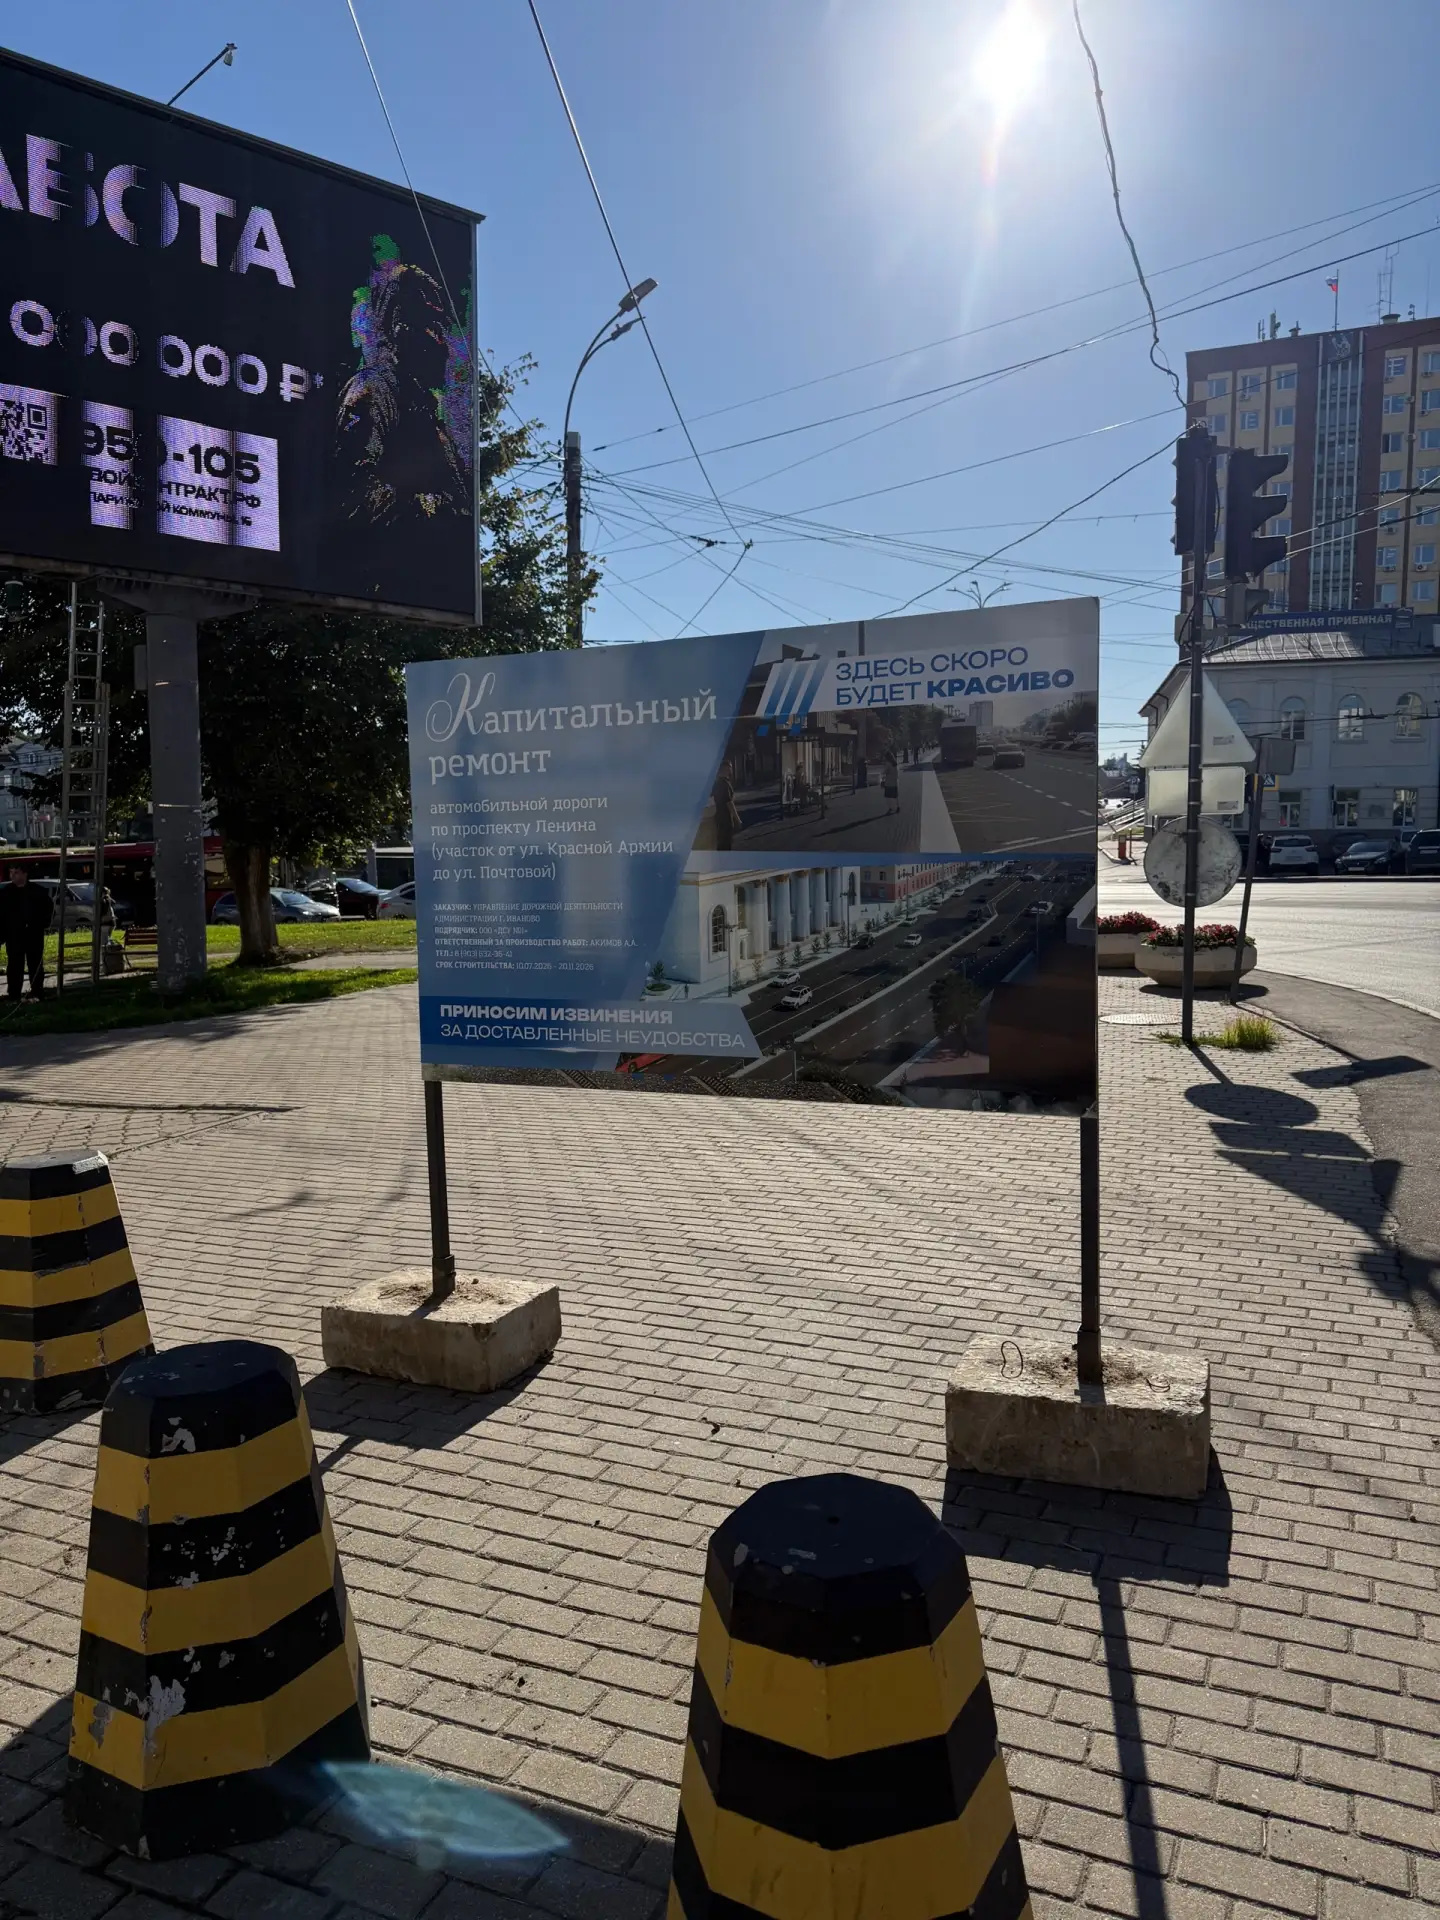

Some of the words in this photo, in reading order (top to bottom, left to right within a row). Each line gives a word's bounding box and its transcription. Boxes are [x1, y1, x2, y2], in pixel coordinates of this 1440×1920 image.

[1328, 615, 1392, 625] ПРИЕМНАЯ
[836, 657, 925, 683] ЗДЕСЬ
[930, 647, 1029, 672] СКОРО
[836, 681, 922, 707] БУДЕТ
[927, 669, 1075, 698] КРАСИВО
[425, 672, 717, 742] Капитальный
[428, 749, 551, 785] ремонт
[430, 797, 548, 814] автомобильной
[552, 797, 608, 813] дороги
[431, 825, 449, 836] по
[452, 821, 531, 838] проспекту
[535, 820, 597, 833] Ленина
[432, 843, 495, 860] (участок
[499, 845, 516, 857] от
[519, 845, 543, 859] ул.
[549, 841, 613, 858] Красной
[617, 840, 673, 857] Армии
[433, 868, 450, 881] до
[454, 867, 476, 880] ул.
[480, 862, 556, 880] Почтовой)
[433, 903, 472, 911] ЗАКАЗЧИК:
[473, 903, 520, 911] УПРАВЛЕНИЕ
[522, 902, 561, 911] ДОРОЖНОЙ
[564, 902, 623, 911] ДЕЯТЕЛЬНОСТИ
[435, 938, 493, 946] ОТВЕТСТВЕННЫЙ
[440, 1004, 547, 1021] ПРИНОСИМ
[551, 1006, 672, 1024] ИЗВИНЕНИЯ
[440, 1024, 463, 1038] ЗА
[465, 1025, 613, 1043] ДОСТАВЛЕННЫЕ
[616, 1031, 745, 1048] НЕУДОБСТВА
